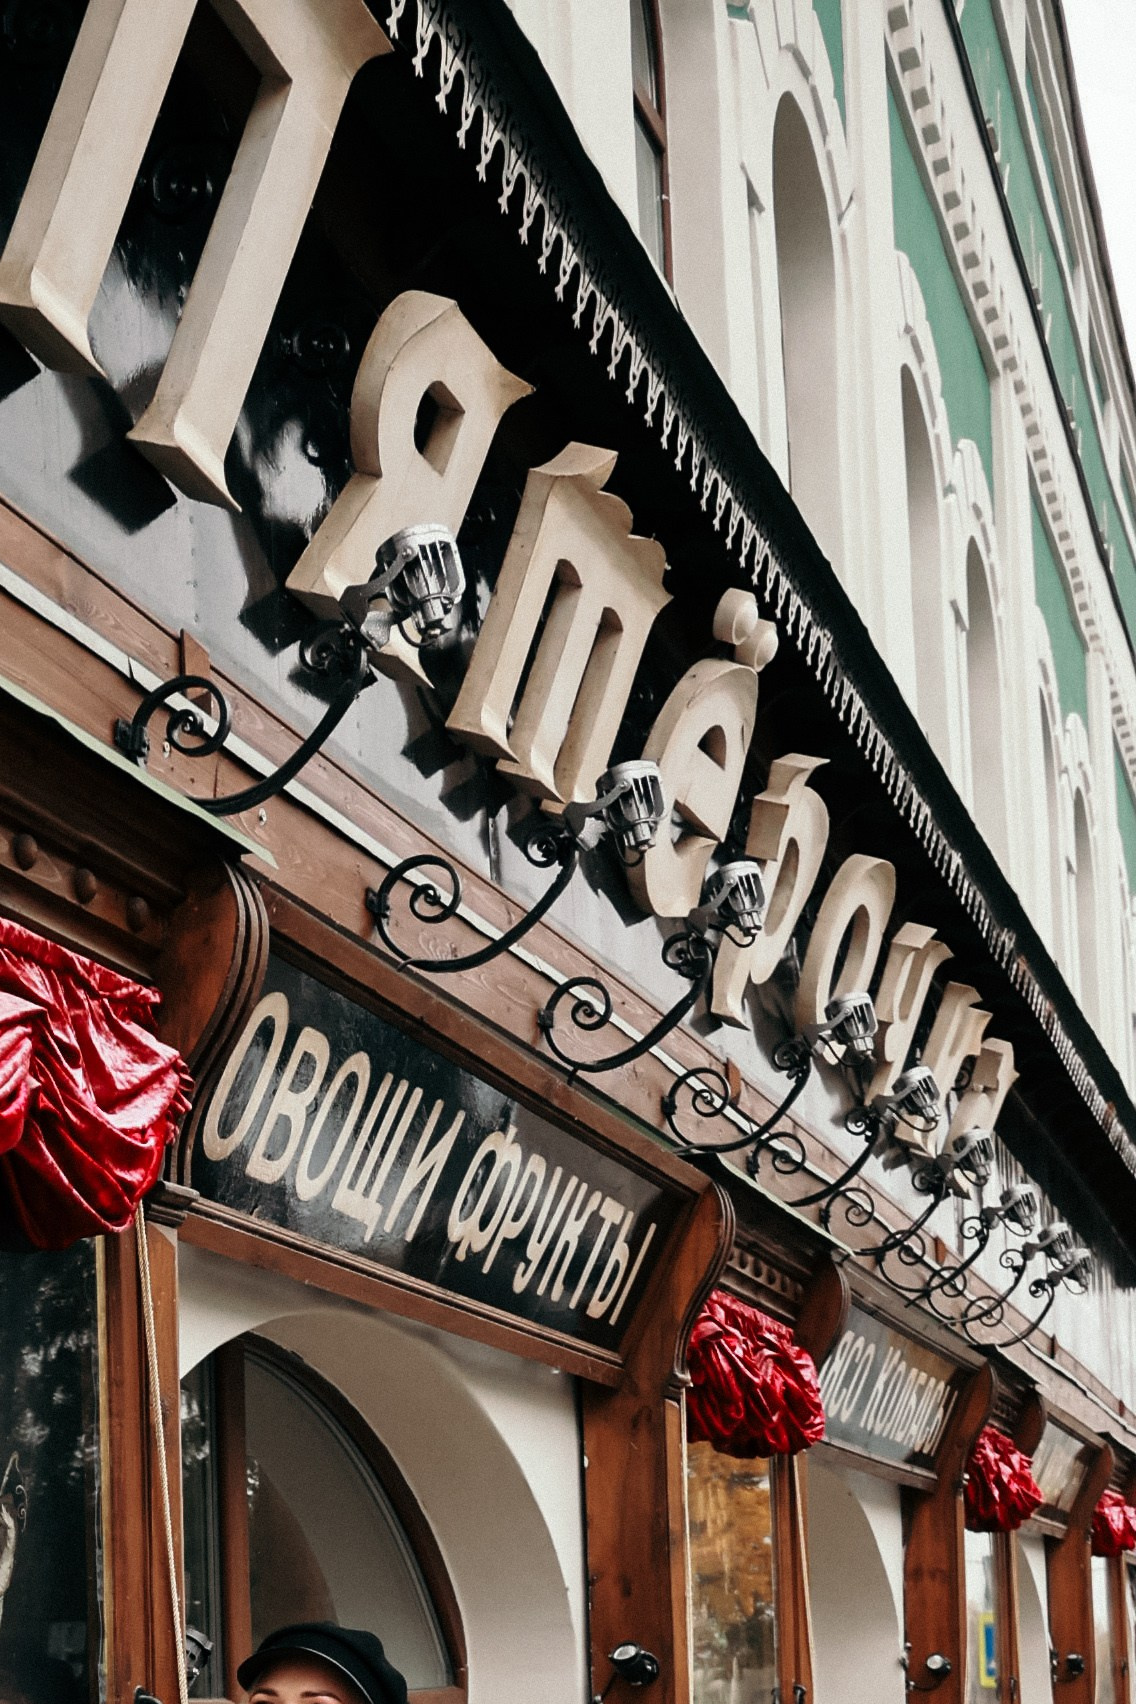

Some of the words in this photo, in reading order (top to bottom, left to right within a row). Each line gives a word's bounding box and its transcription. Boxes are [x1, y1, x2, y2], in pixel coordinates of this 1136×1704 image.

[202, 991, 466, 1243] ОВОЩИ
[447, 1125, 657, 1326] ФРУКТЫ
[819, 1330, 876, 1424] ЯСО
[859, 1346, 959, 1457] КОЛБАСЫ
